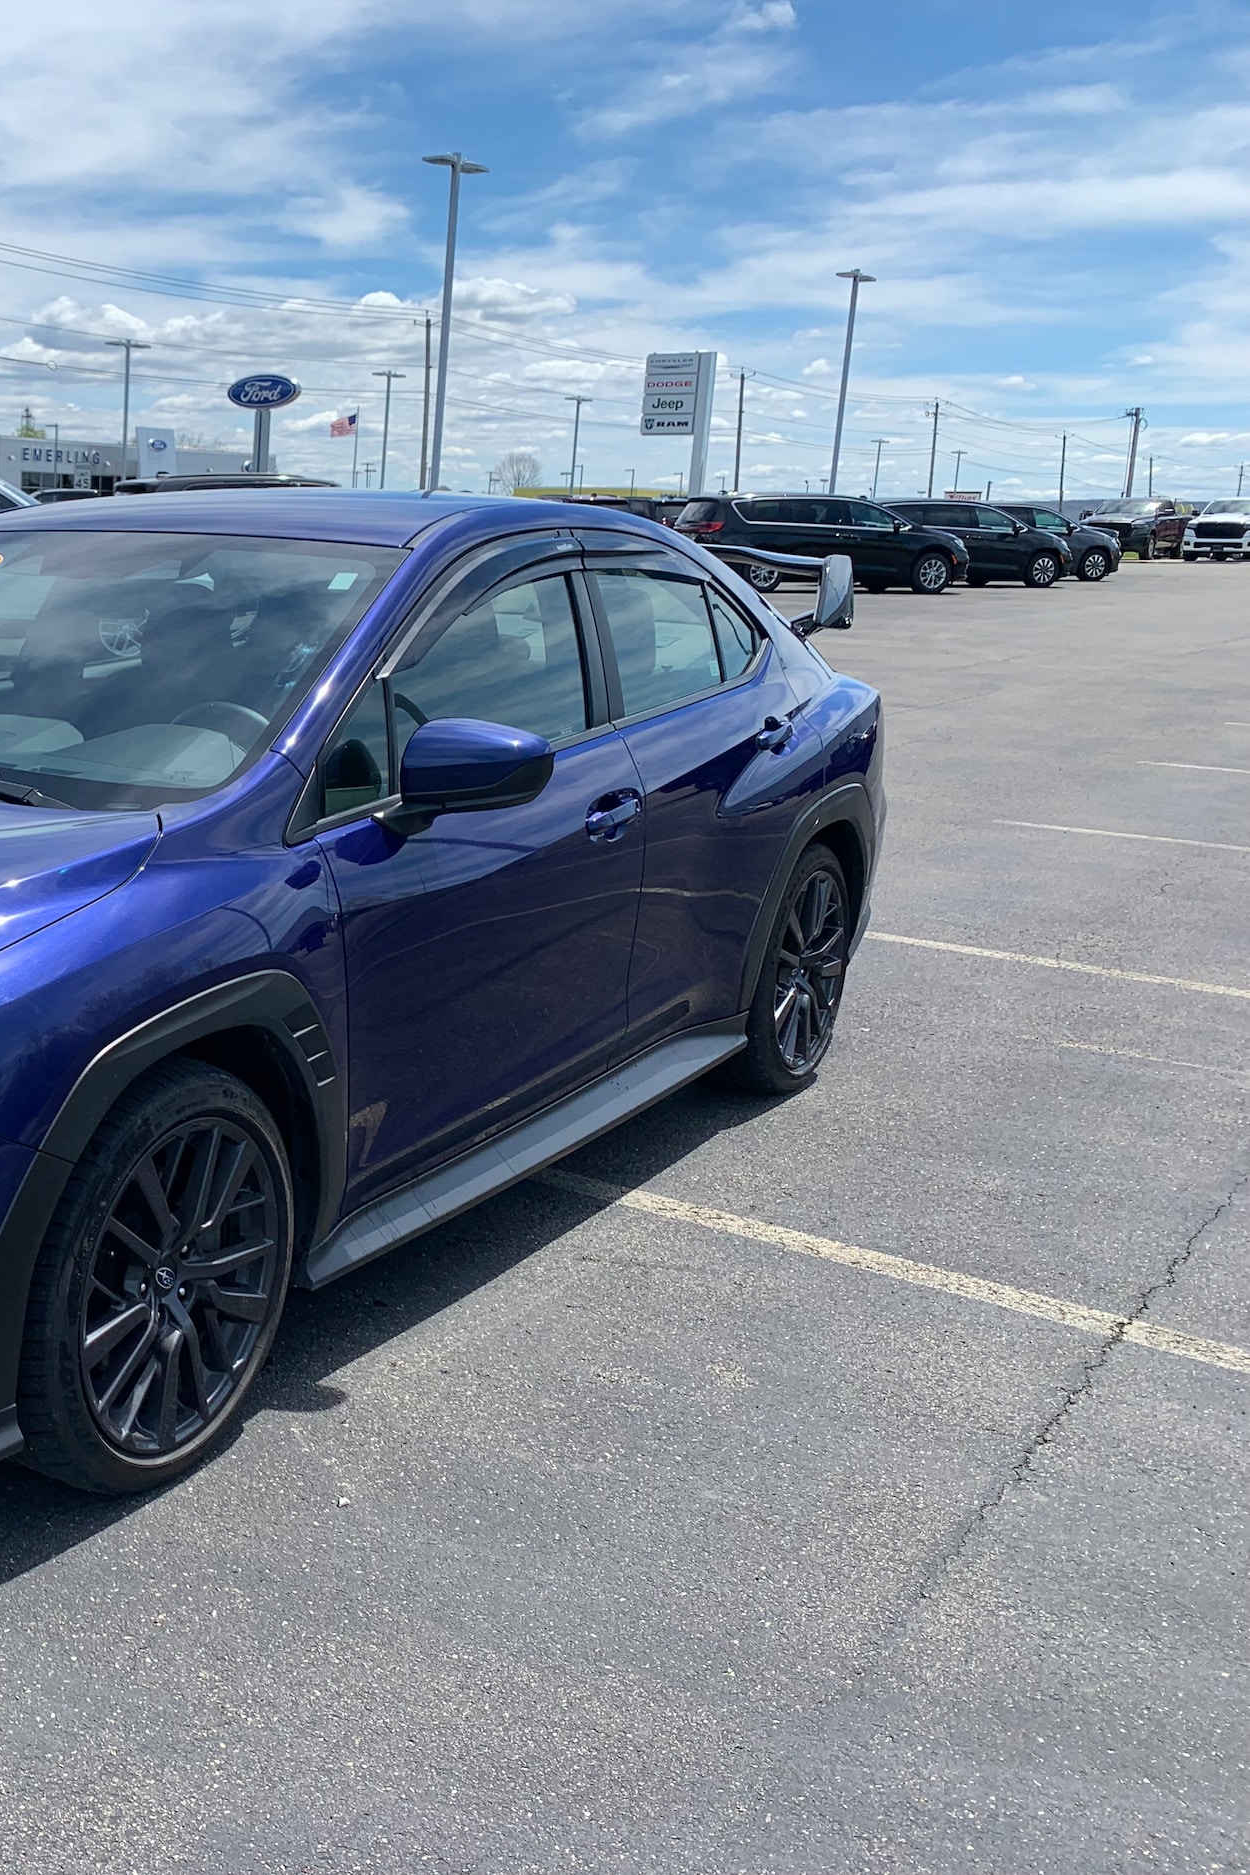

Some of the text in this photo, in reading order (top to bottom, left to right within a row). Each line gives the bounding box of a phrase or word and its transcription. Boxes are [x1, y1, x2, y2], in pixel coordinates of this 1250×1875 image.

[240, 381, 282, 402] Ford
[652, 398, 684, 411] Jeep
[22, 447, 100, 464] EMERLING
[75, 478, 89, 489] 45
